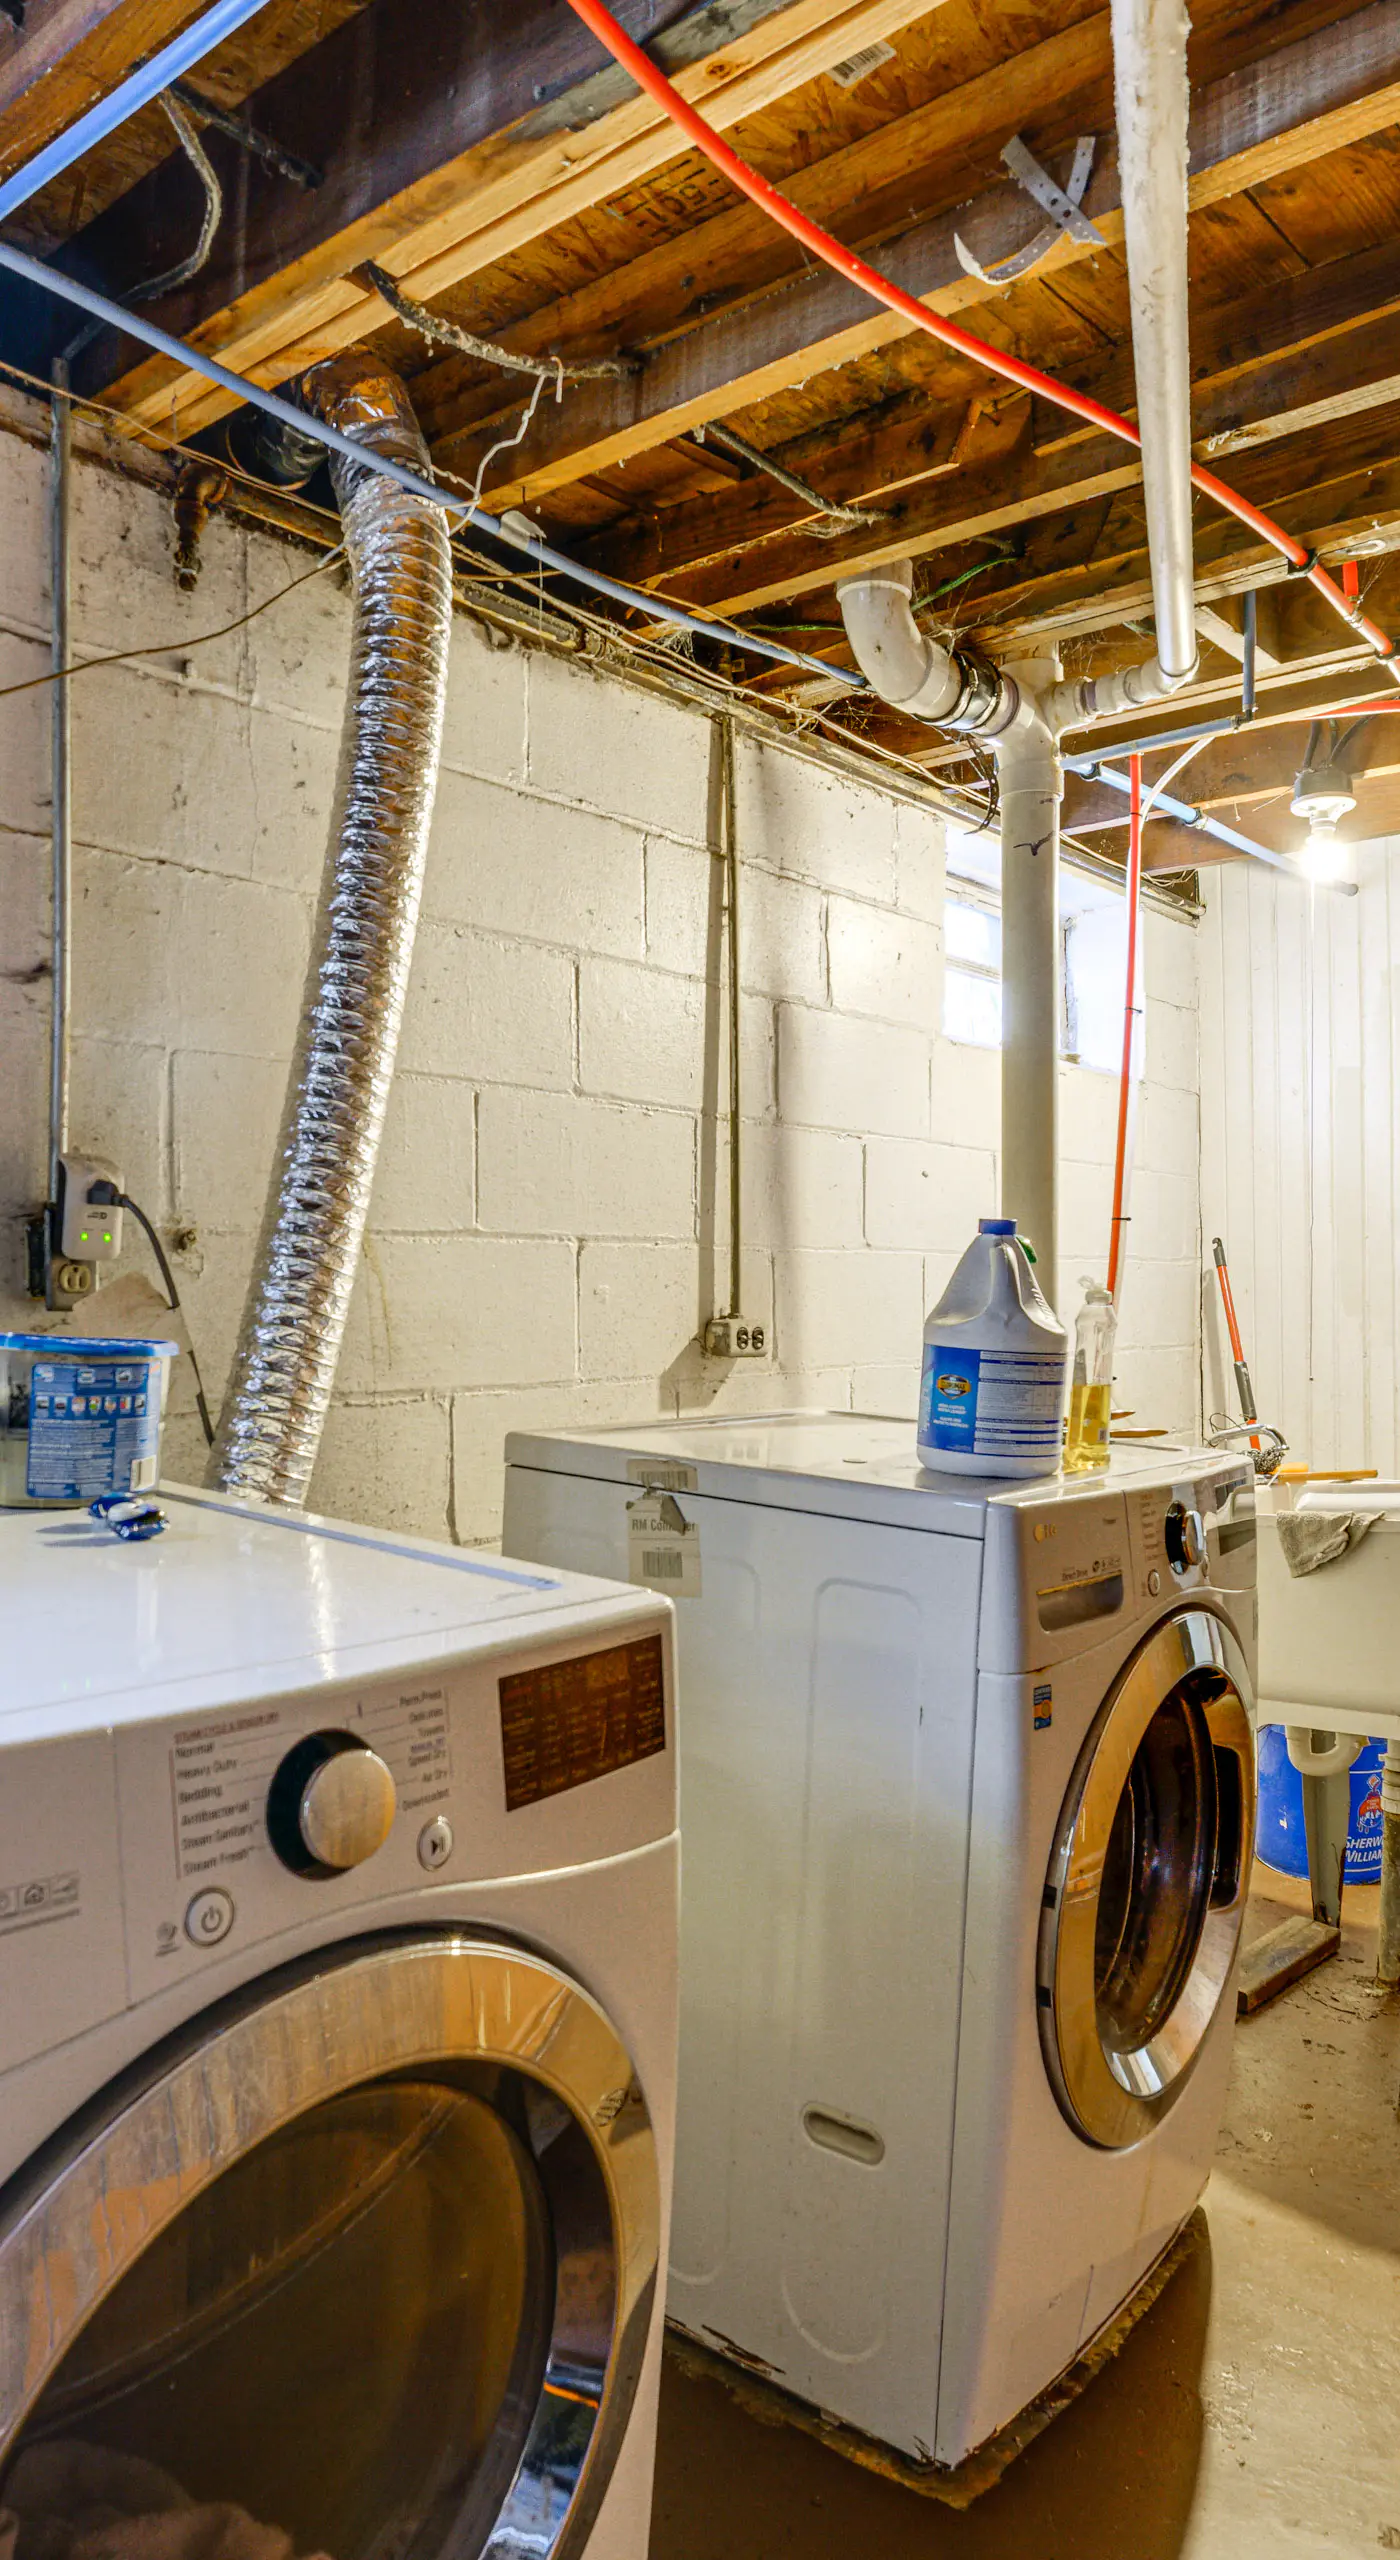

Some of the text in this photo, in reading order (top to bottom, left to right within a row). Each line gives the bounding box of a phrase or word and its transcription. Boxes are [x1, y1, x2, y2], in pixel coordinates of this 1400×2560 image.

[175, 1741, 215, 1759] Normal
[177, 1759, 239, 1780] Heavy Duty
[178, 1785, 223, 1805] Bedding
[181, 1800, 250, 1827] Antibacterial
[182, 1836, 213, 1850] Steam
[183, 1857, 218, 1877] Steam
